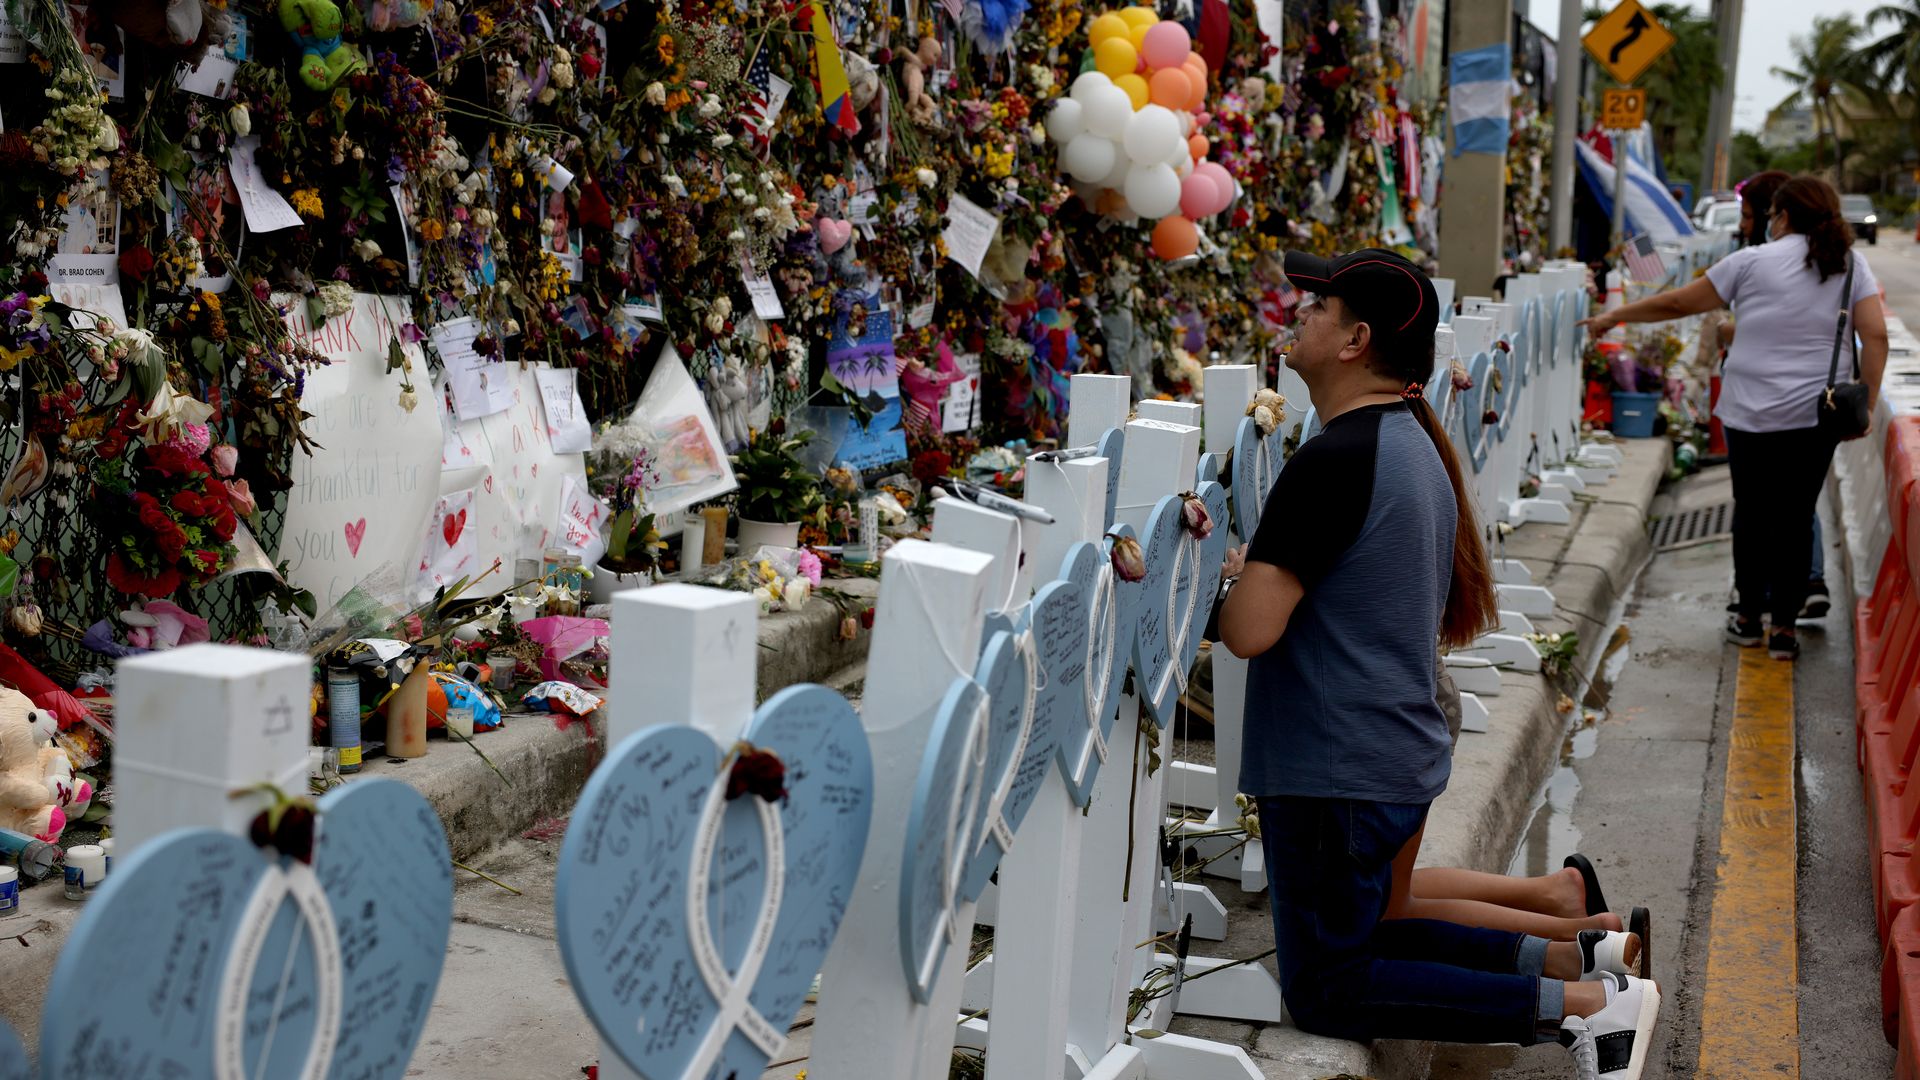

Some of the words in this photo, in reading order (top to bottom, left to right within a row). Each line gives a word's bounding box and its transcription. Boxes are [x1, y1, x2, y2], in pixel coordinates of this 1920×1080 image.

[1608, 94, 1639, 114] 20
[69, 268, 84, 276] BRAD
[85, 268, 105, 276] COHEN
[348, 392, 377, 431] are
[296, 448, 381, 505] thankful
[393, 451, 422, 494] for
[287, 528, 336, 574] you
